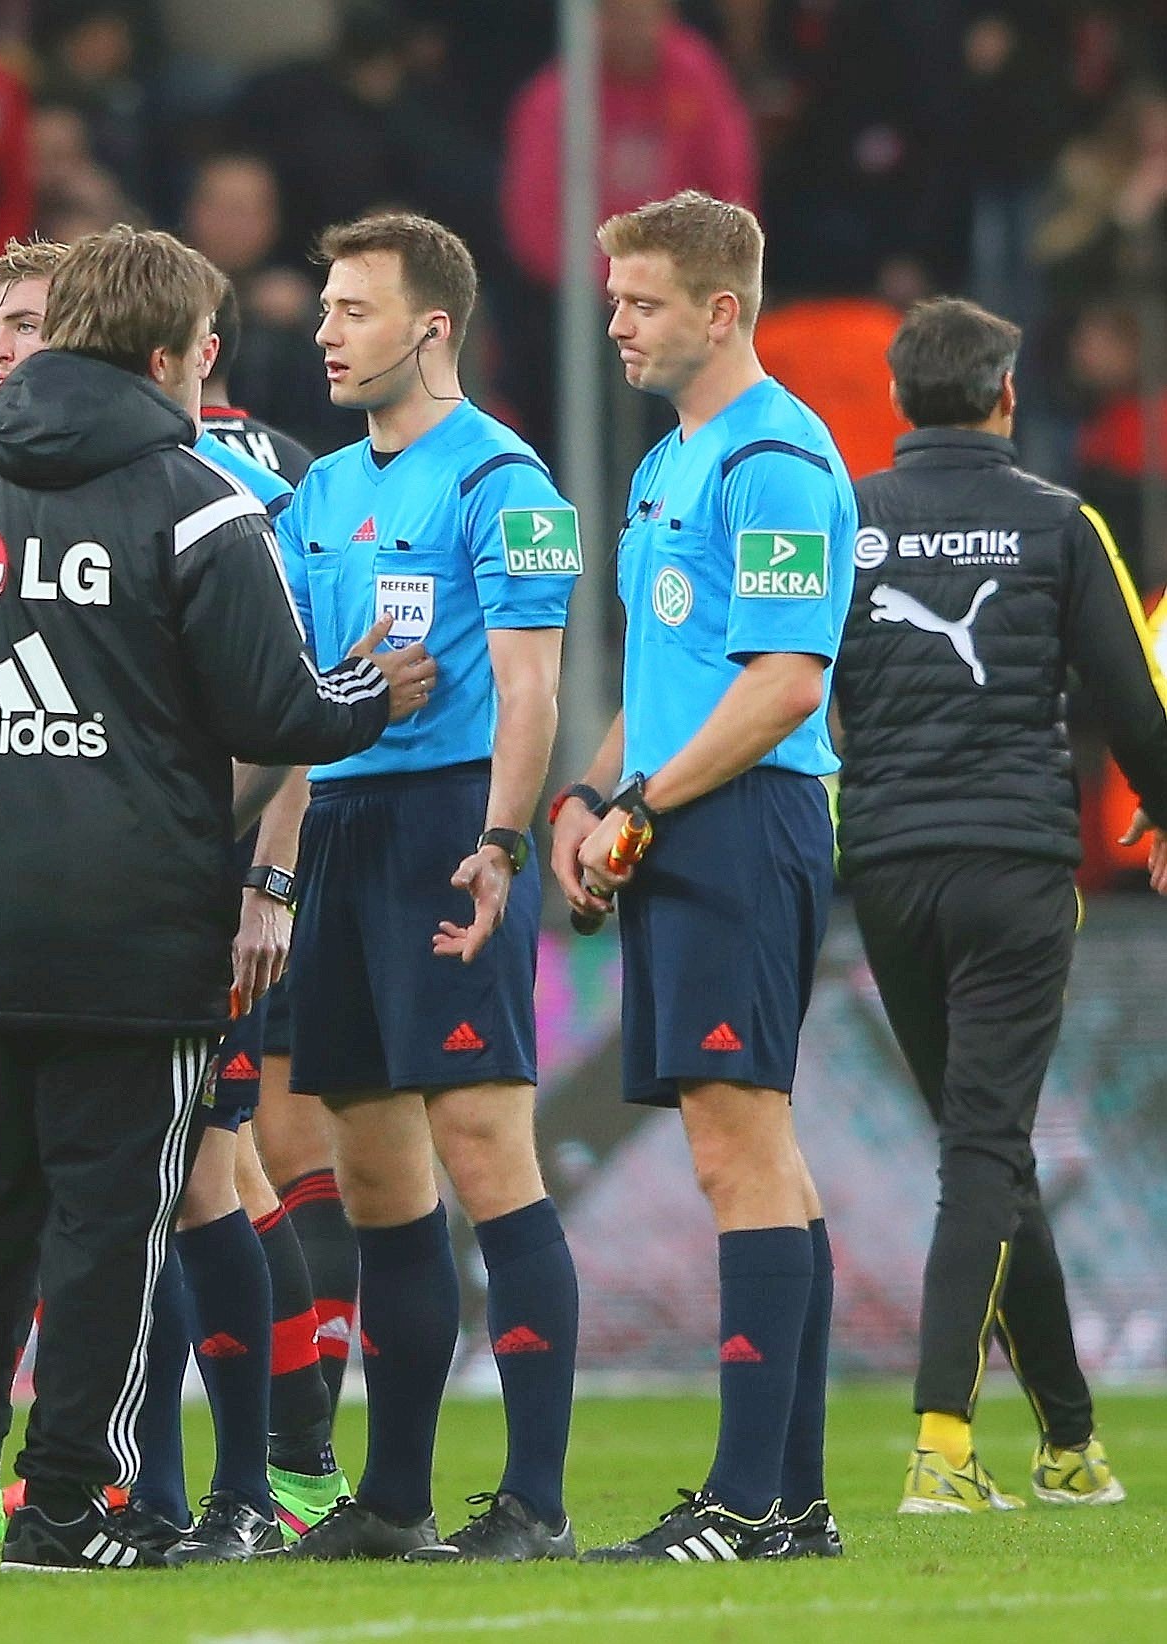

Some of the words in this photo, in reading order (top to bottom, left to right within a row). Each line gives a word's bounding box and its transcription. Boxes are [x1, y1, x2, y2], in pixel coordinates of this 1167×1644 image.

[897, 529, 1021, 558] EVONIK
[19, 536, 112, 606] LG
[509, 547, 580, 572] DEKRA
[380, 580, 430, 593] REFEREE
[740, 570, 824, 596] DEKRA
